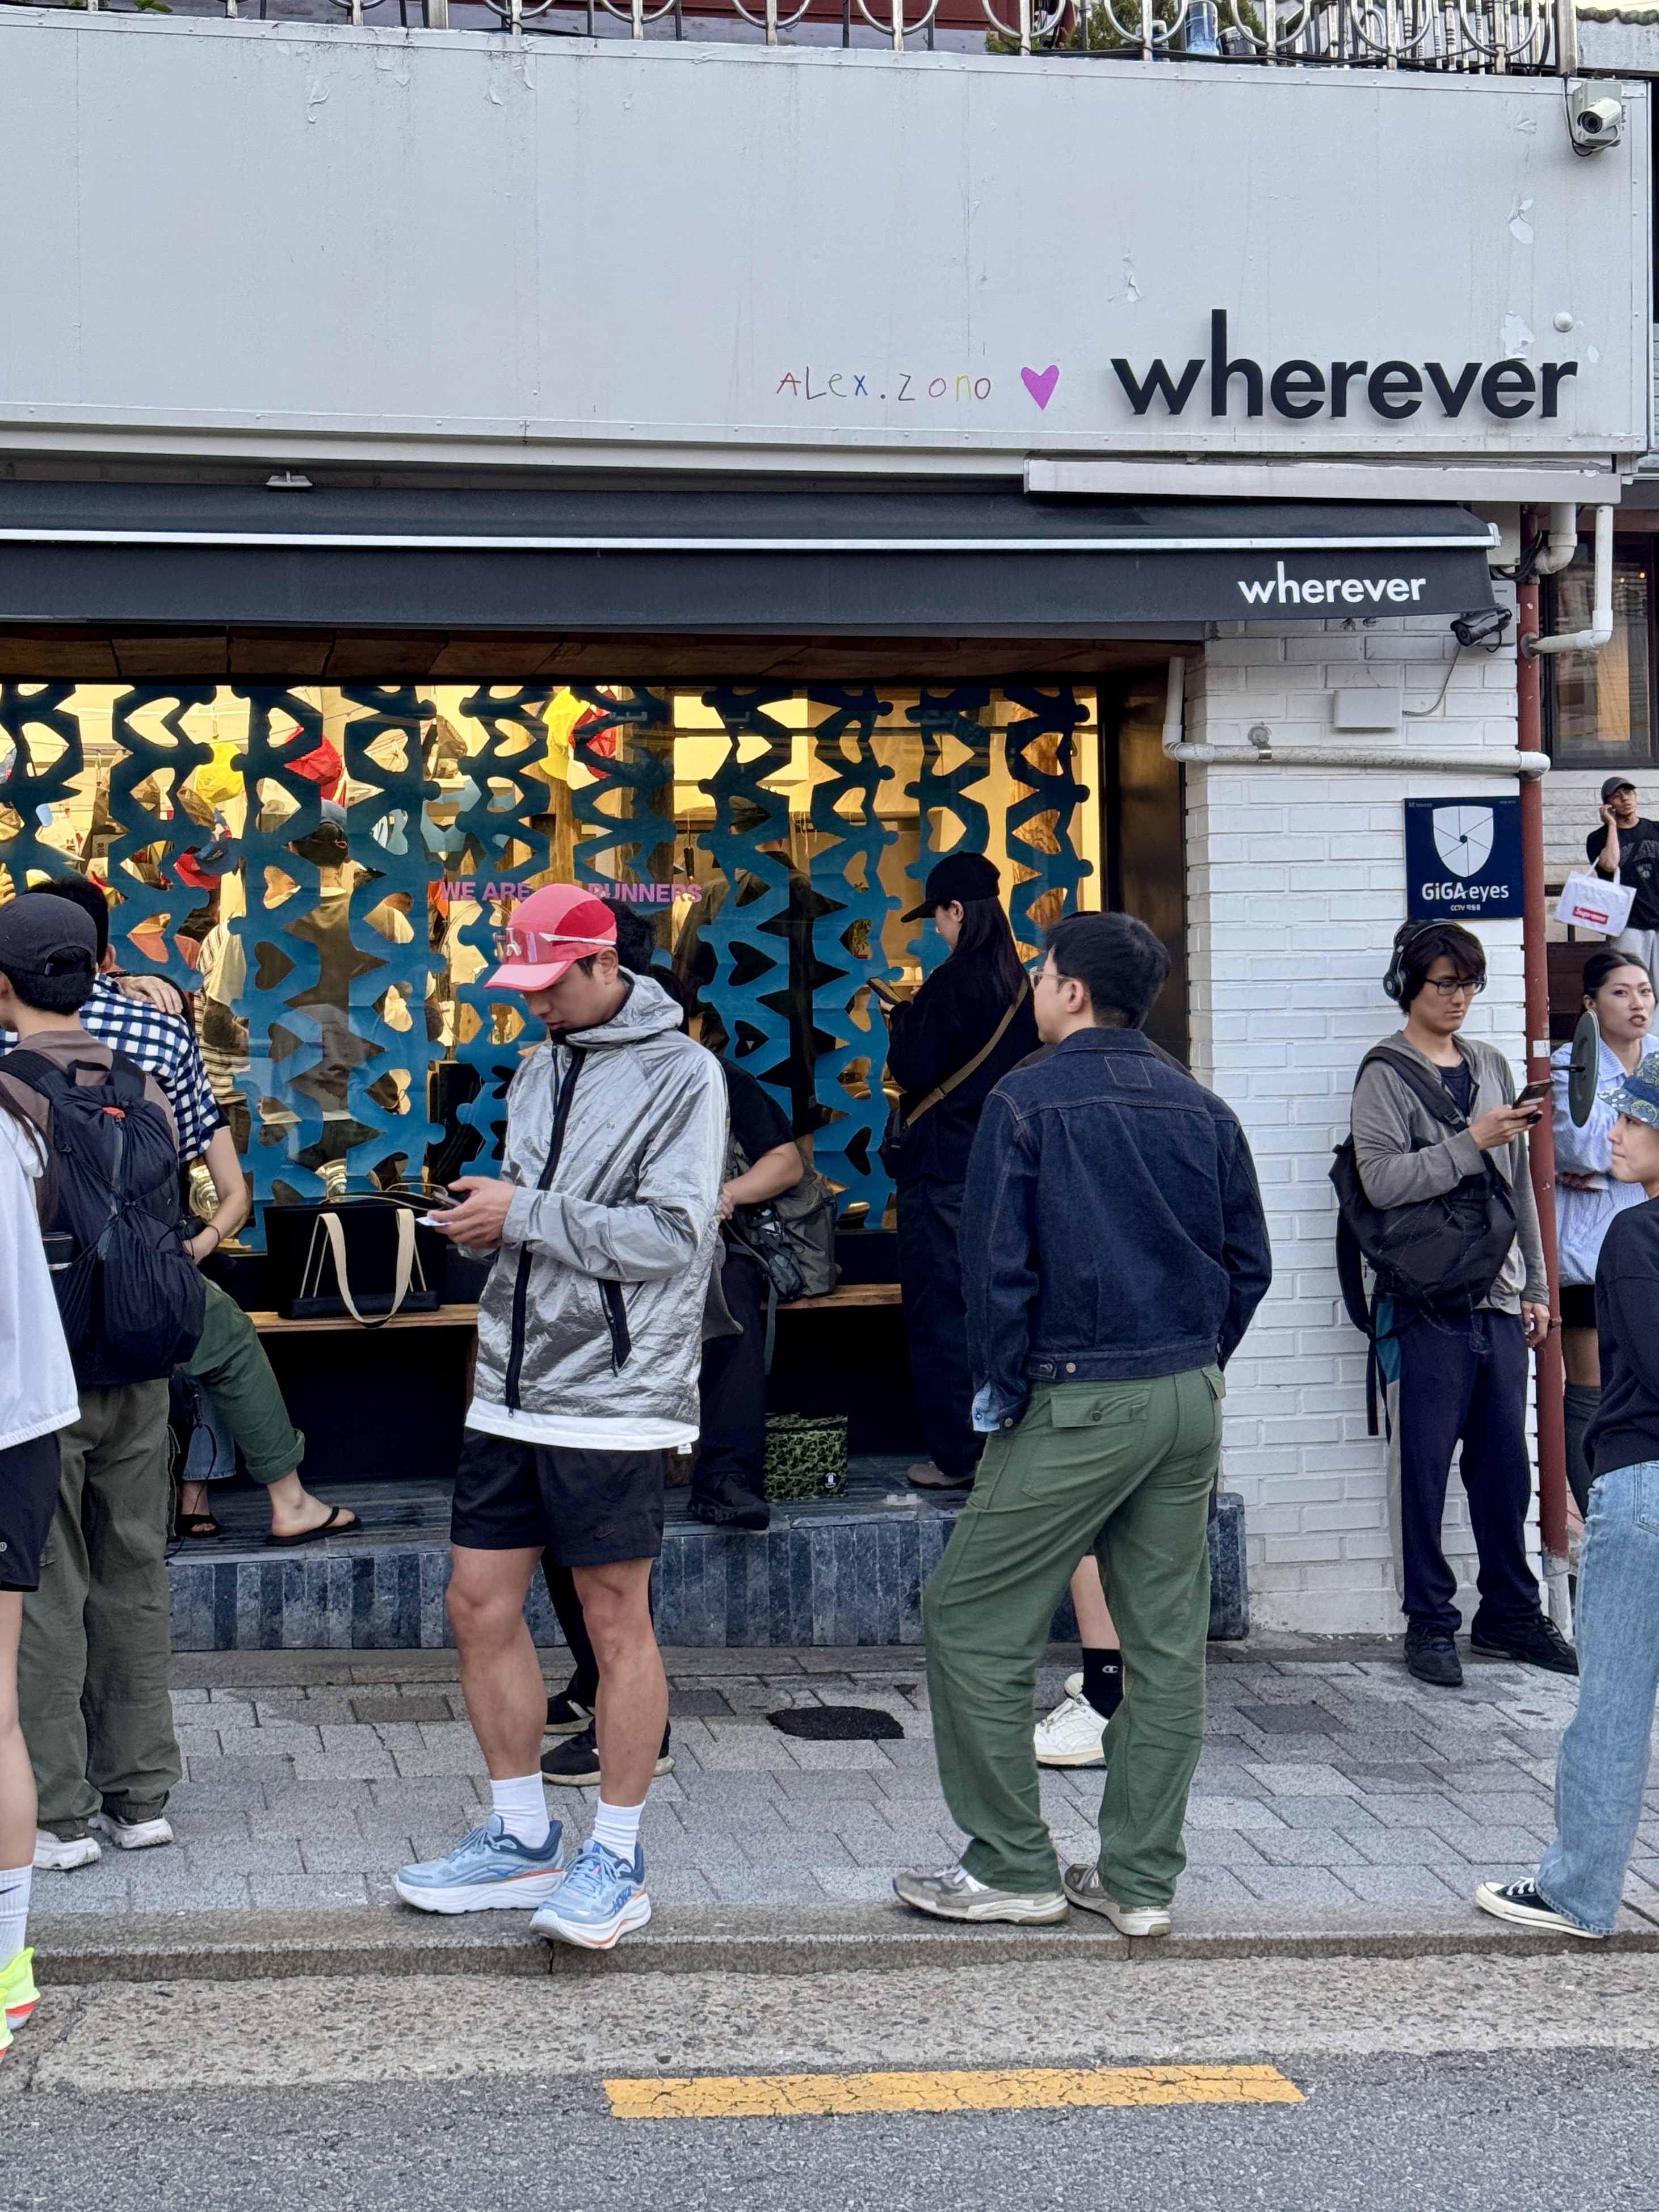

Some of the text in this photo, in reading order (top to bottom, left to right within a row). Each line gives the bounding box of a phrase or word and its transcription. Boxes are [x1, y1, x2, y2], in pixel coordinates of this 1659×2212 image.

[1112, 310, 1578, 419] wherever
[1238, 561, 1426, 603] wherever
[440, 881, 702, 903] WE ARE RUNNERS
